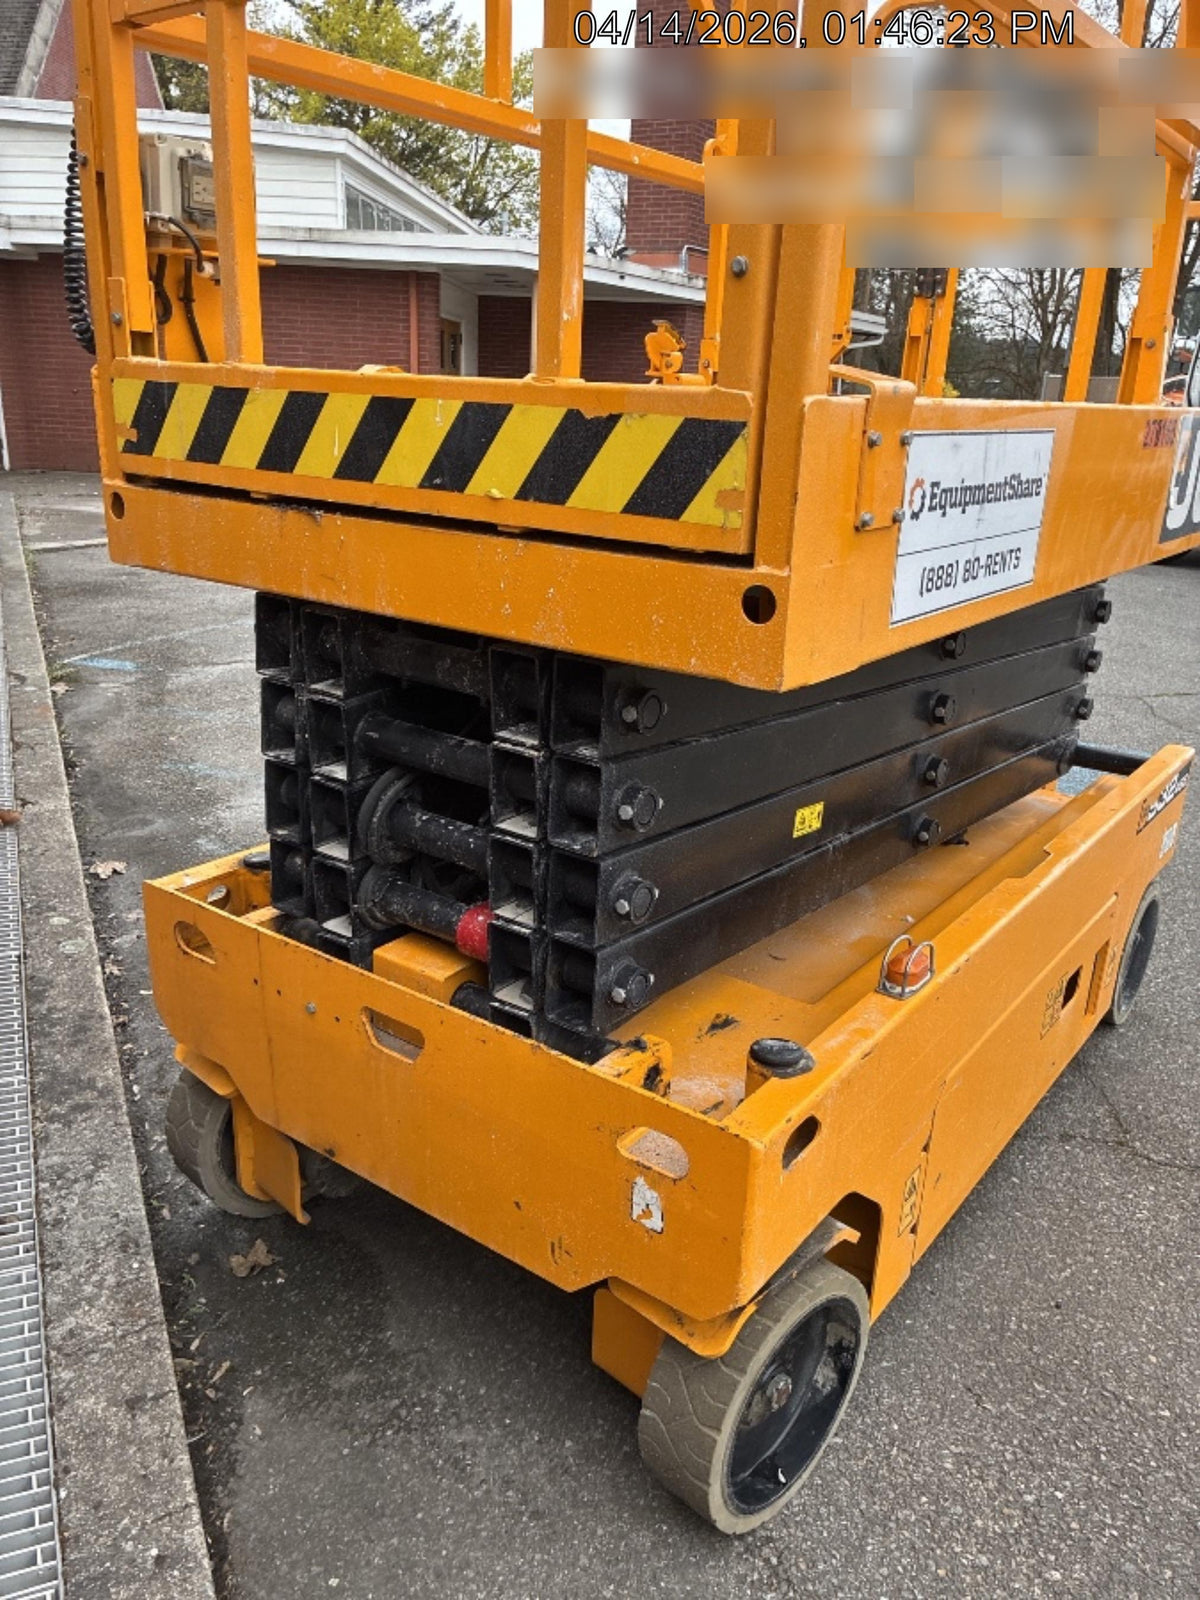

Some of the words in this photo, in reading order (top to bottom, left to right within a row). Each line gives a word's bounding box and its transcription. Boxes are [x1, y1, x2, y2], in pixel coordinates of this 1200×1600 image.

[927, 473, 1043, 518] EquipmentShare
[918, 559, 960, 598] (888)
[961, 547, 1022, 584] 80-RENTS
